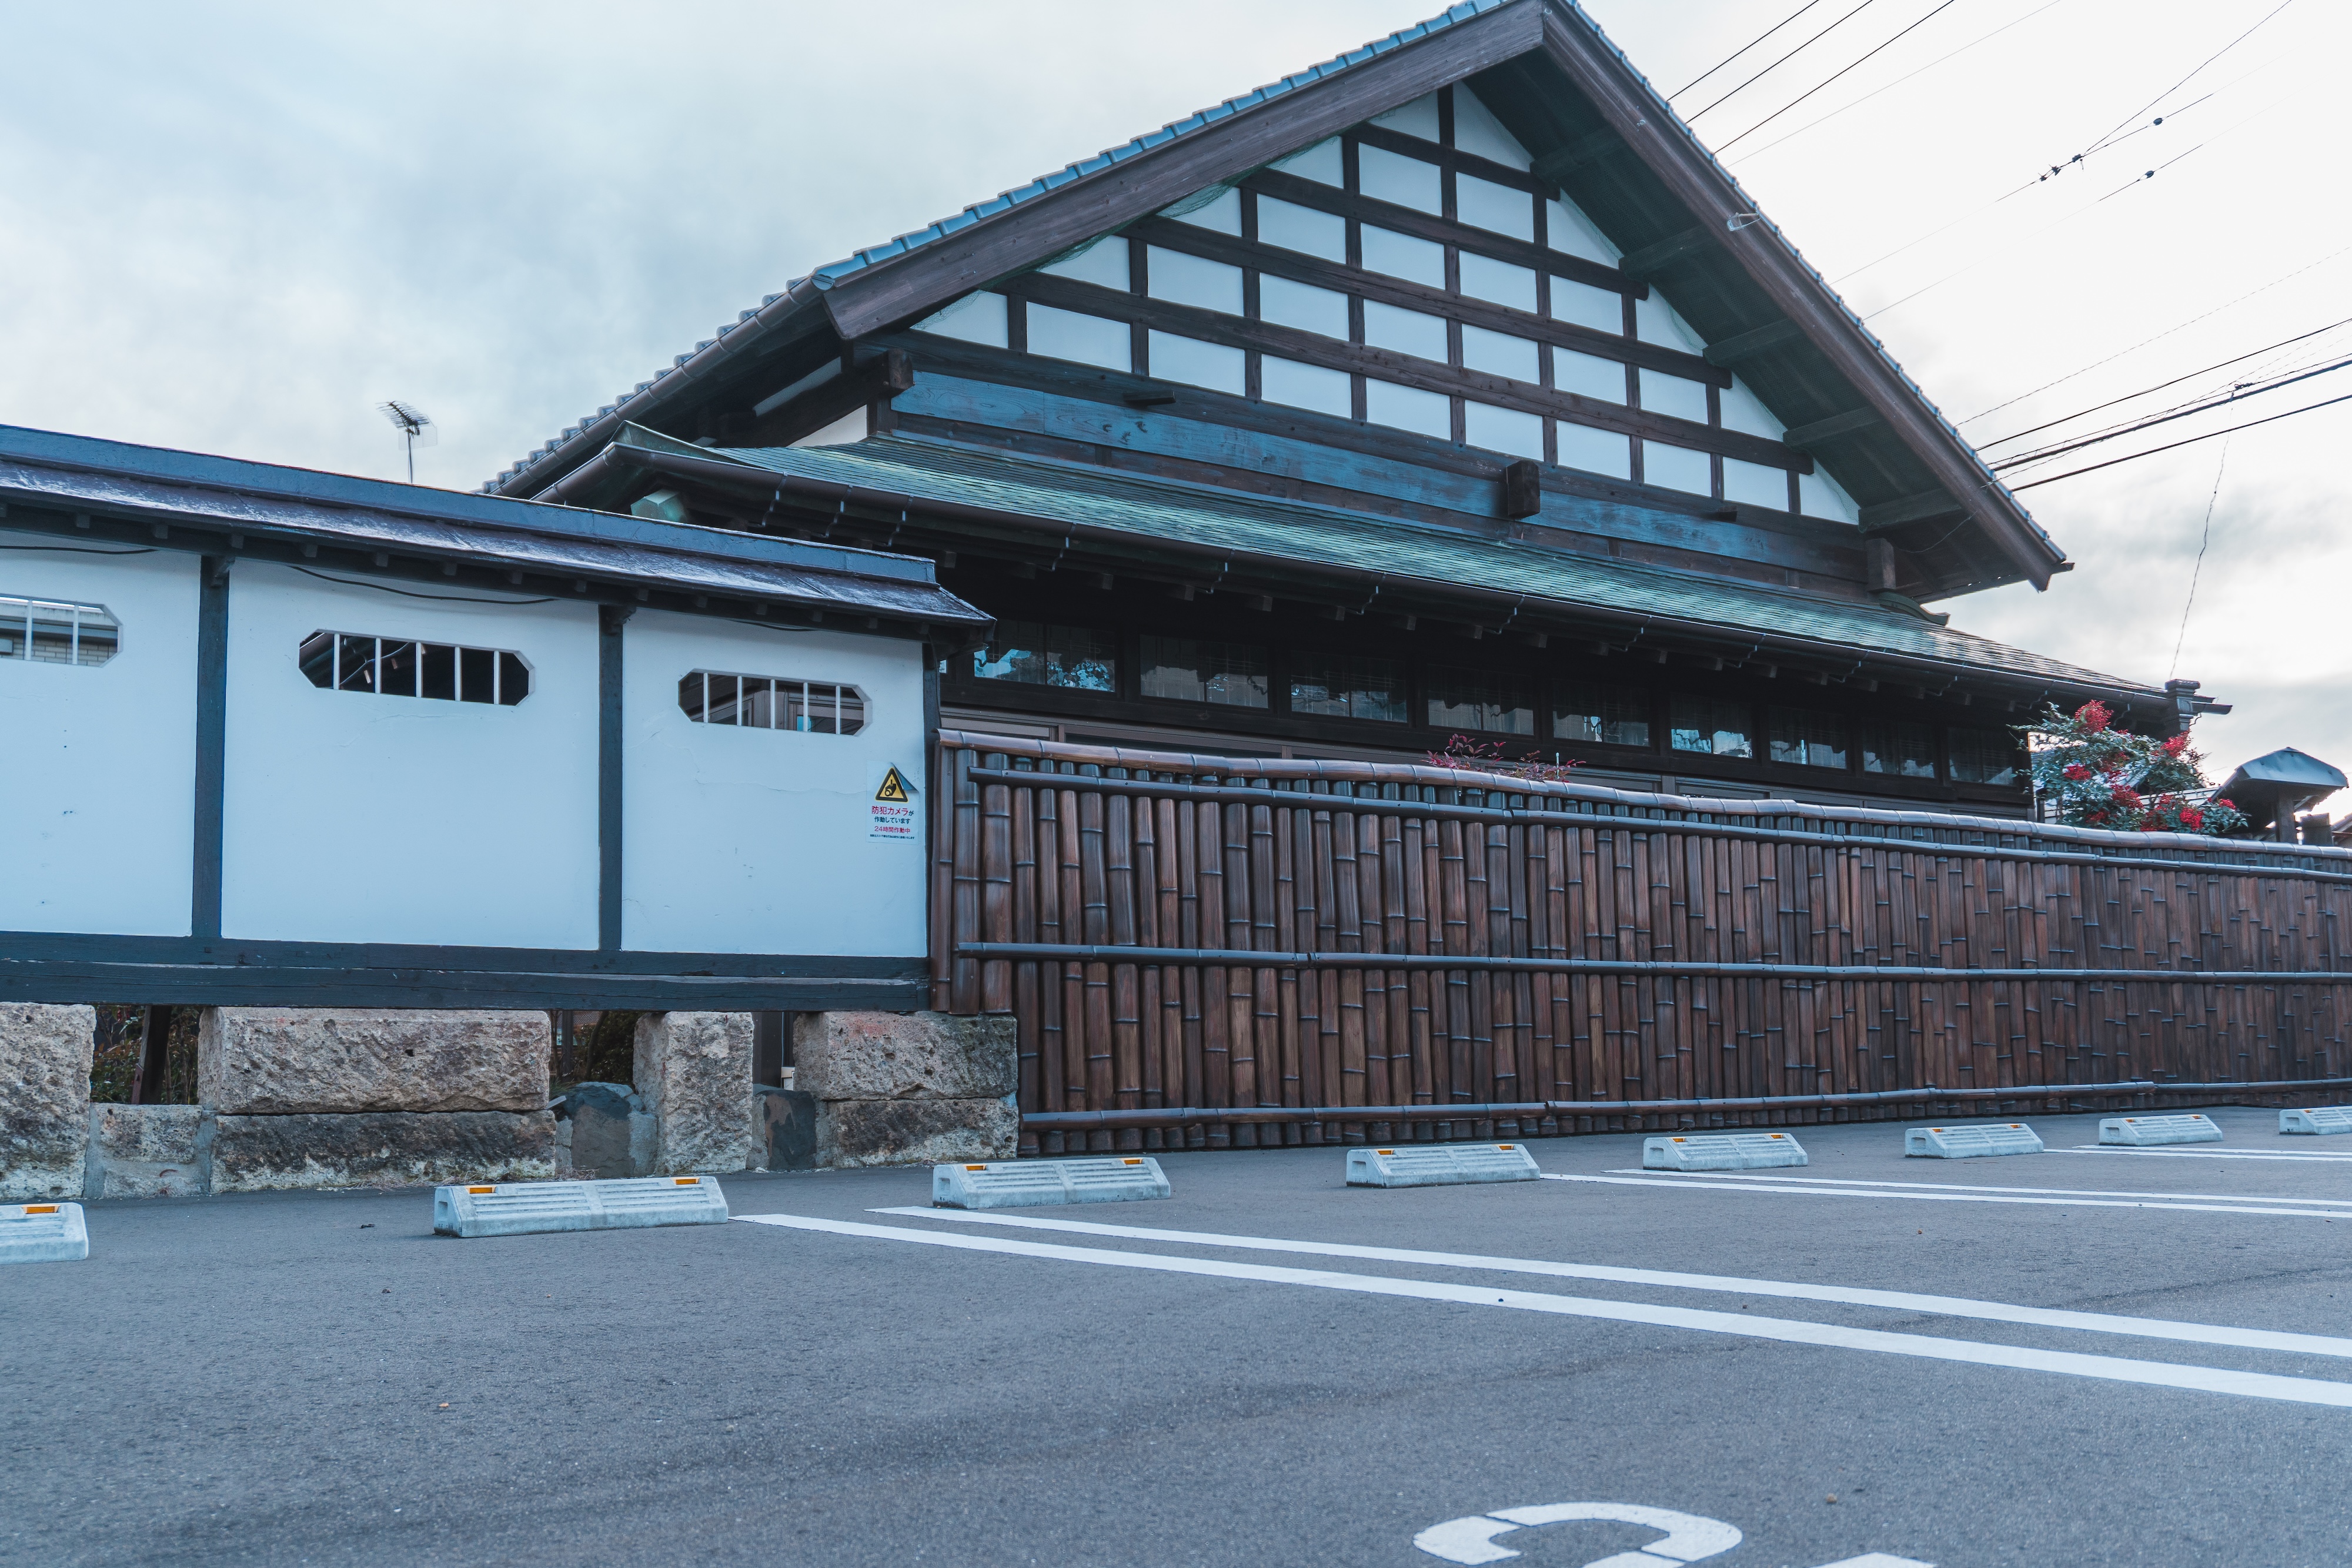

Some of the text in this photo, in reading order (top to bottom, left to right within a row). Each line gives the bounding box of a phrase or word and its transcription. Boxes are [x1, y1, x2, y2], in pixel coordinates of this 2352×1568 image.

[871, 805, 914, 816] 防犯カメラが
[874, 816, 910, 824] 作動しています
[874, 825, 910, 834] 24時間作動中
